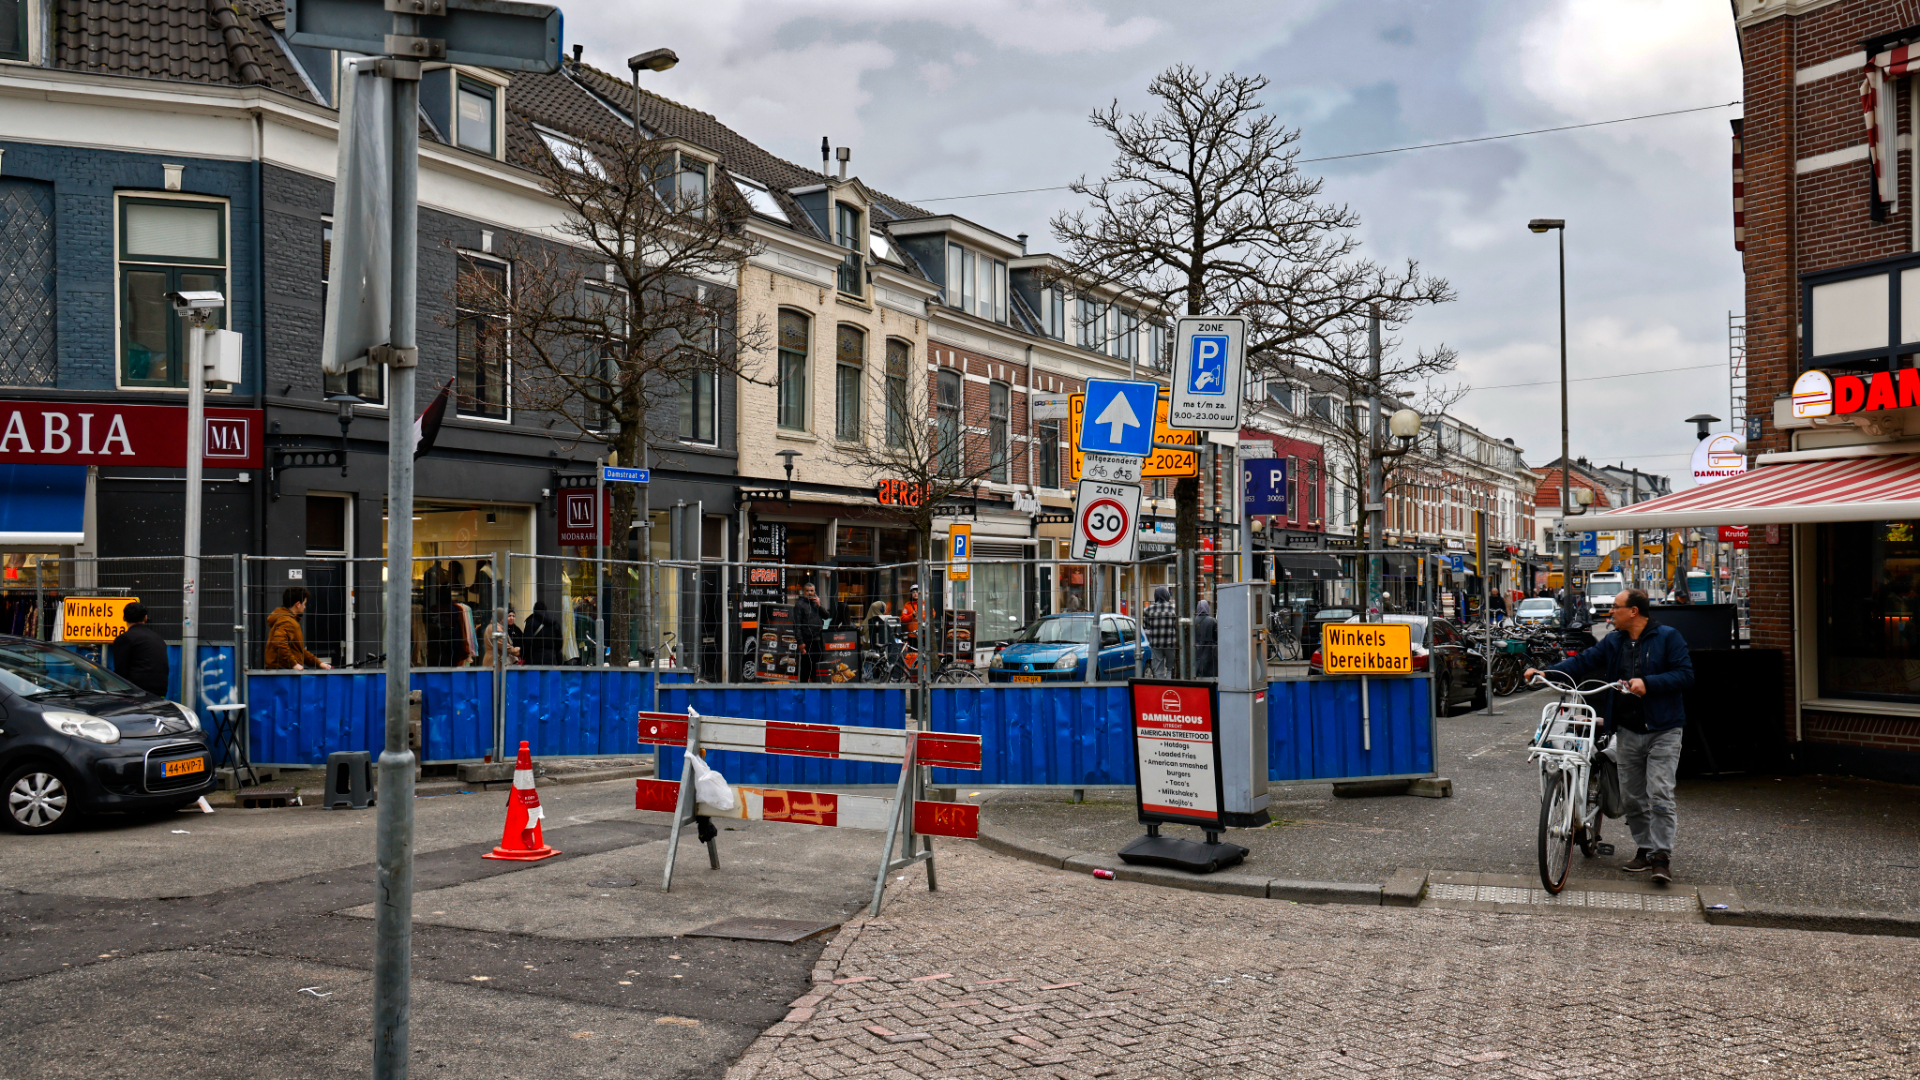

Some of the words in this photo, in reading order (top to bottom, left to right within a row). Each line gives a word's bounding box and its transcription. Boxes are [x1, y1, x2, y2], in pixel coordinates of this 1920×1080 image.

[1198, 323, 1224, 332] ZONE
[1198, 341, 1219, 369] P
[1197, 401, 1213, 409] t/m
[1174, 412, 1220, 420] 9.00-23.00
[0, 410, 136, 456] ABIA
[211, 426, 242, 450] MA
[1087, 455, 1138, 465] uitgezonderd
[607, 470, 638, 479] Damstraat
[1270, 470, 1283, 489] P
[1096, 485, 1124, 496] ZONE
[572, 502, 590, 520] MA
[1091, 512, 1121, 532] 30
[561, 532, 598, 540] MODARABI
[956, 537, 964, 554] P
[67, 603, 113, 617] Winkels
[66, 622, 126, 637] bereikbaa
[1329, 629, 1385, 646] Winkels
[1330, 651, 1408, 669] bereikbaar
[1142, 713, 1203, 724] DAMNLICIOUS
[1141, 729, 1171, 737] AMERICAN
[1172, 731, 1209, 740] STREETFOOD
[1164, 742, 1189, 750] Hotdogs
[168, 759, 203, 775] 44-KVP-7
[1147, 759, 1178, 767] American
[1179, 762, 1208, 770] smashed
[1166, 770, 1190, 778] burgers
[1162, 789, 1198, 798] Milkshake's
[1168, 799, 1193, 807] Mojito's
[934, 806, 966, 827] KR
